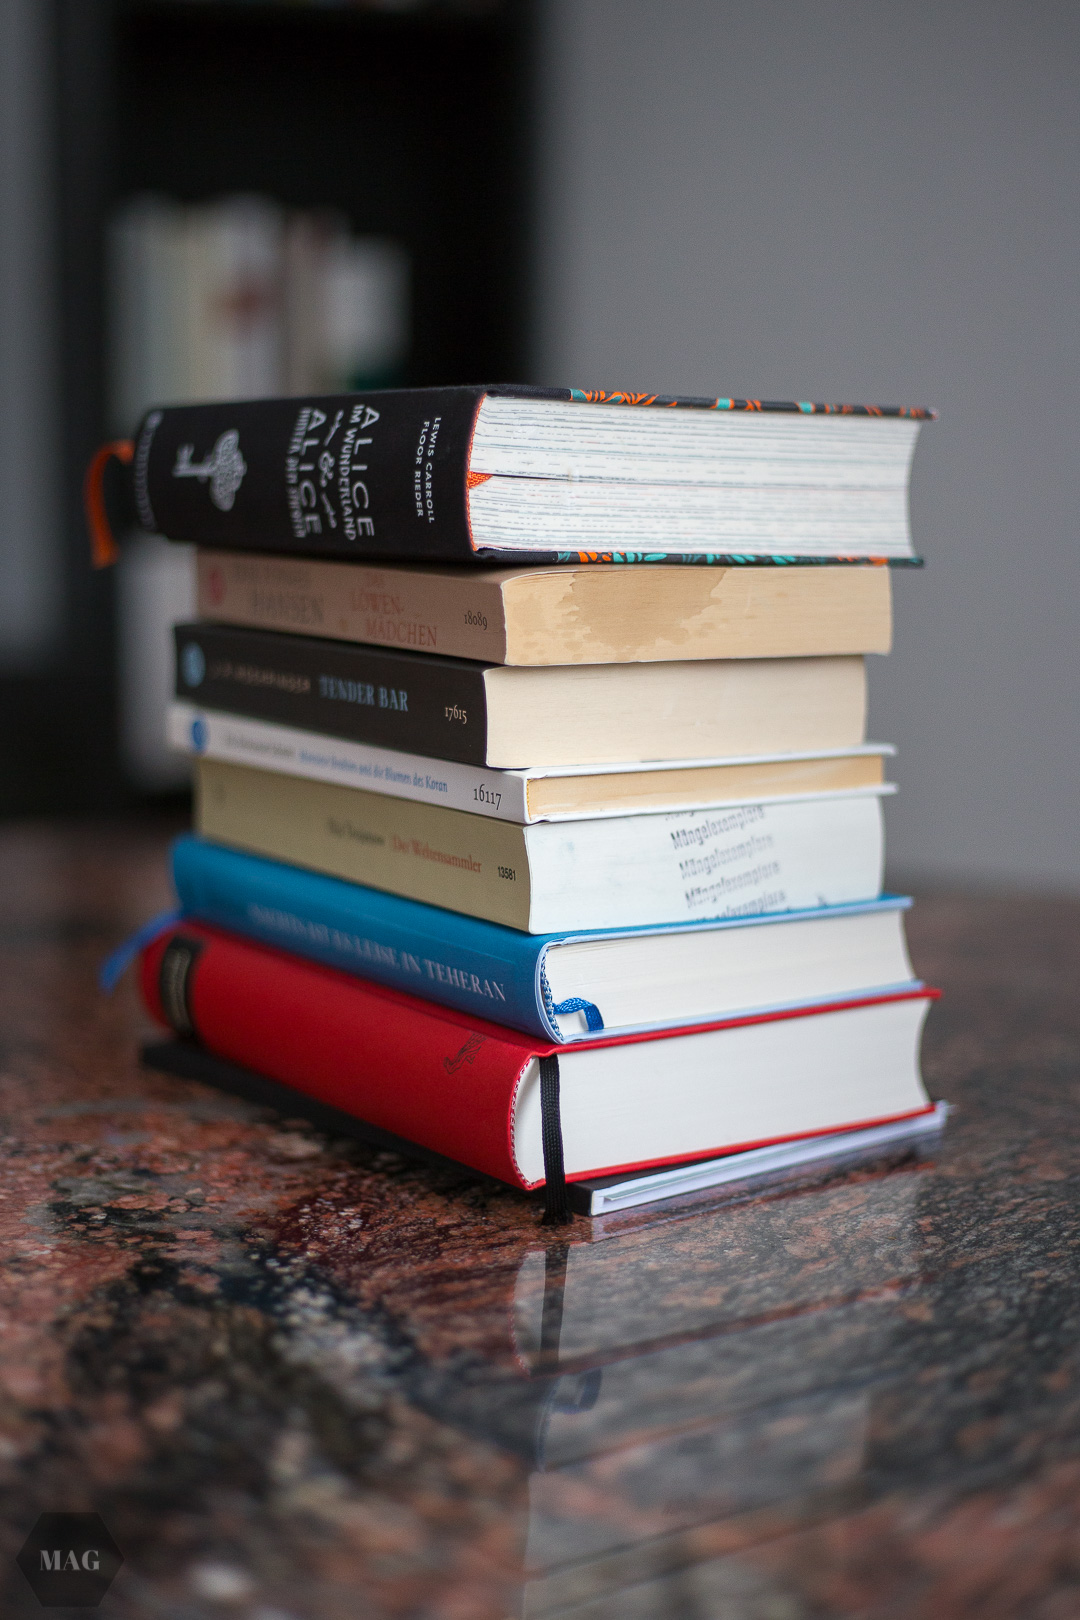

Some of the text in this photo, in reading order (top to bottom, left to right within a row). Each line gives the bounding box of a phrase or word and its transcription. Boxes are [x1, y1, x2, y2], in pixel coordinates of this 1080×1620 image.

[299, 408, 327, 534] ALICE
[318, 450, 335, 488] &
[338, 404, 366, 541] IM WUNDERLAND
[351, 406, 380, 537] ALICE
[414, 421, 430, 517] FLOOR RIEDER
[425, 417, 442, 523] LEWIS CARROLL
[463, 610, 488, 631] 18089
[318, 674, 375, 706] TENDER
[377, 684, 409, 712] BAR
[444, 704, 468, 725] 17615
[412, 772, 425, 789] des
[425, 775, 449, 793] Koran
[473, 783, 502, 811] 16117
[670, 805, 766, 850] Mängelexemplare
[410, 837, 483, 874] Weltensammler
[497, 865, 517, 882] 13581
[678, 833, 774, 880] Mängelexemplare
[685, 860, 780, 909] Mängelexemplare
[423, 958, 506, 1002] TEHERAN
